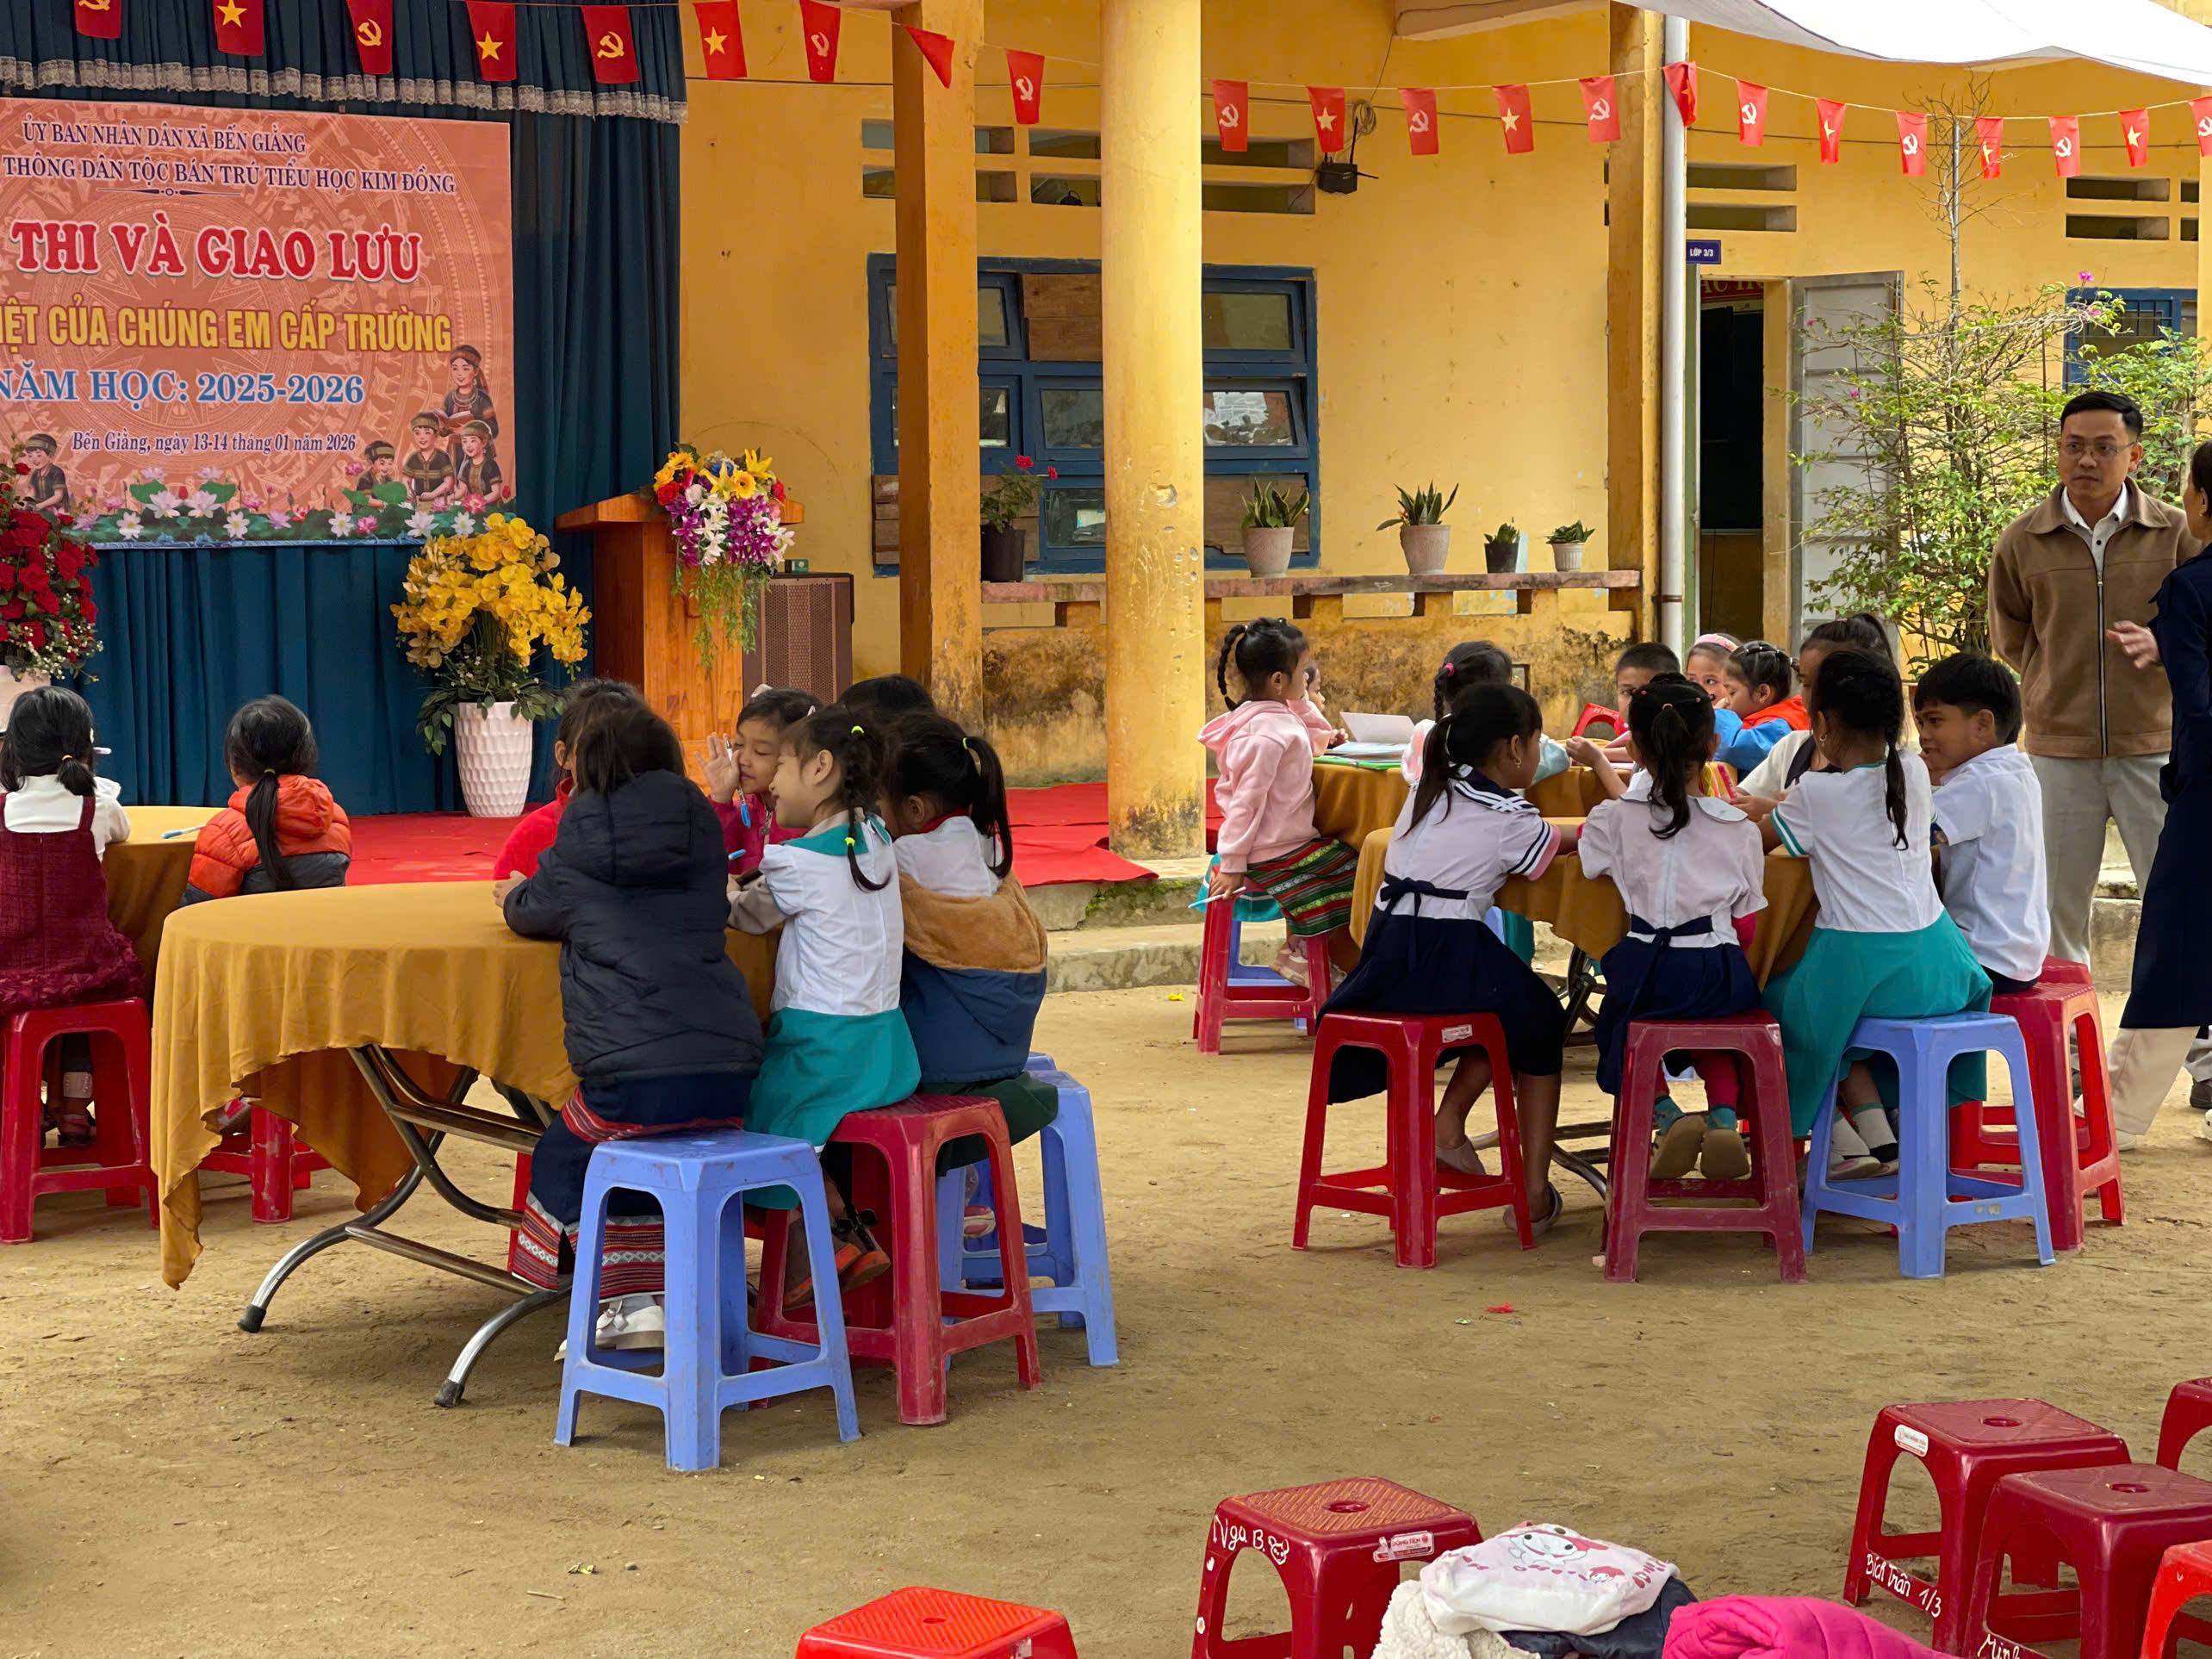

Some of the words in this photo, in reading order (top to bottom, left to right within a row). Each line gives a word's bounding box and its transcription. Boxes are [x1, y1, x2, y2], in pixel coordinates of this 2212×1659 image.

[23, 115, 46, 142] ỦY
[52, 123, 88, 143] BAN
[92, 121, 142, 146] NHÂN
[147, 123, 183, 147] DÂN
[187, 125, 209, 149] XÃ
[214, 125, 247, 150] BẾN
[252, 125, 306, 153] GIẰNG
[3, 152, 76, 177] THÔNG
[82, 155, 124, 180] DÂN
[129, 157, 169, 185] TỘC
[175, 159, 214, 183] BÁN
[220, 161, 259, 185] TRÚ
[265, 158, 310, 187] TIỂU
[316, 169, 356, 193] HỌC
[362, 172, 397, 190] KIM
[401, 165, 455, 193] ĐỒNG
[10, 220, 100, 272] THI
[110, 211, 185, 275] VÀ
[196, 227, 316, 280] GIAO
[328, 223, 421, 283] LƯU
[1690, 247, 1702, 257] LỚP
[48, 293, 109, 345] CỦA
[117, 301, 219, 348] CHÚNG
[227, 310, 271, 349] EM
[280, 297, 336, 351] CẤP
[345, 305, 451, 352] TRƯỜNG
[89, 371, 187, 410] HỌC:
[198, 373, 363, 403] 2025-2026
[73, 431, 100, 450] Bến
[105, 428, 150, 454] Giằng,
[155, 433, 189, 453] ngày
[194, 433, 227, 450] 13-14
[233, 434, 270, 453] tháng
[275, 434, 289, 450] 01
[294, 435, 322, 450] năm
[326, 434, 356, 450] 2026
[1919, 1587, 1942, 1618] 1/3
